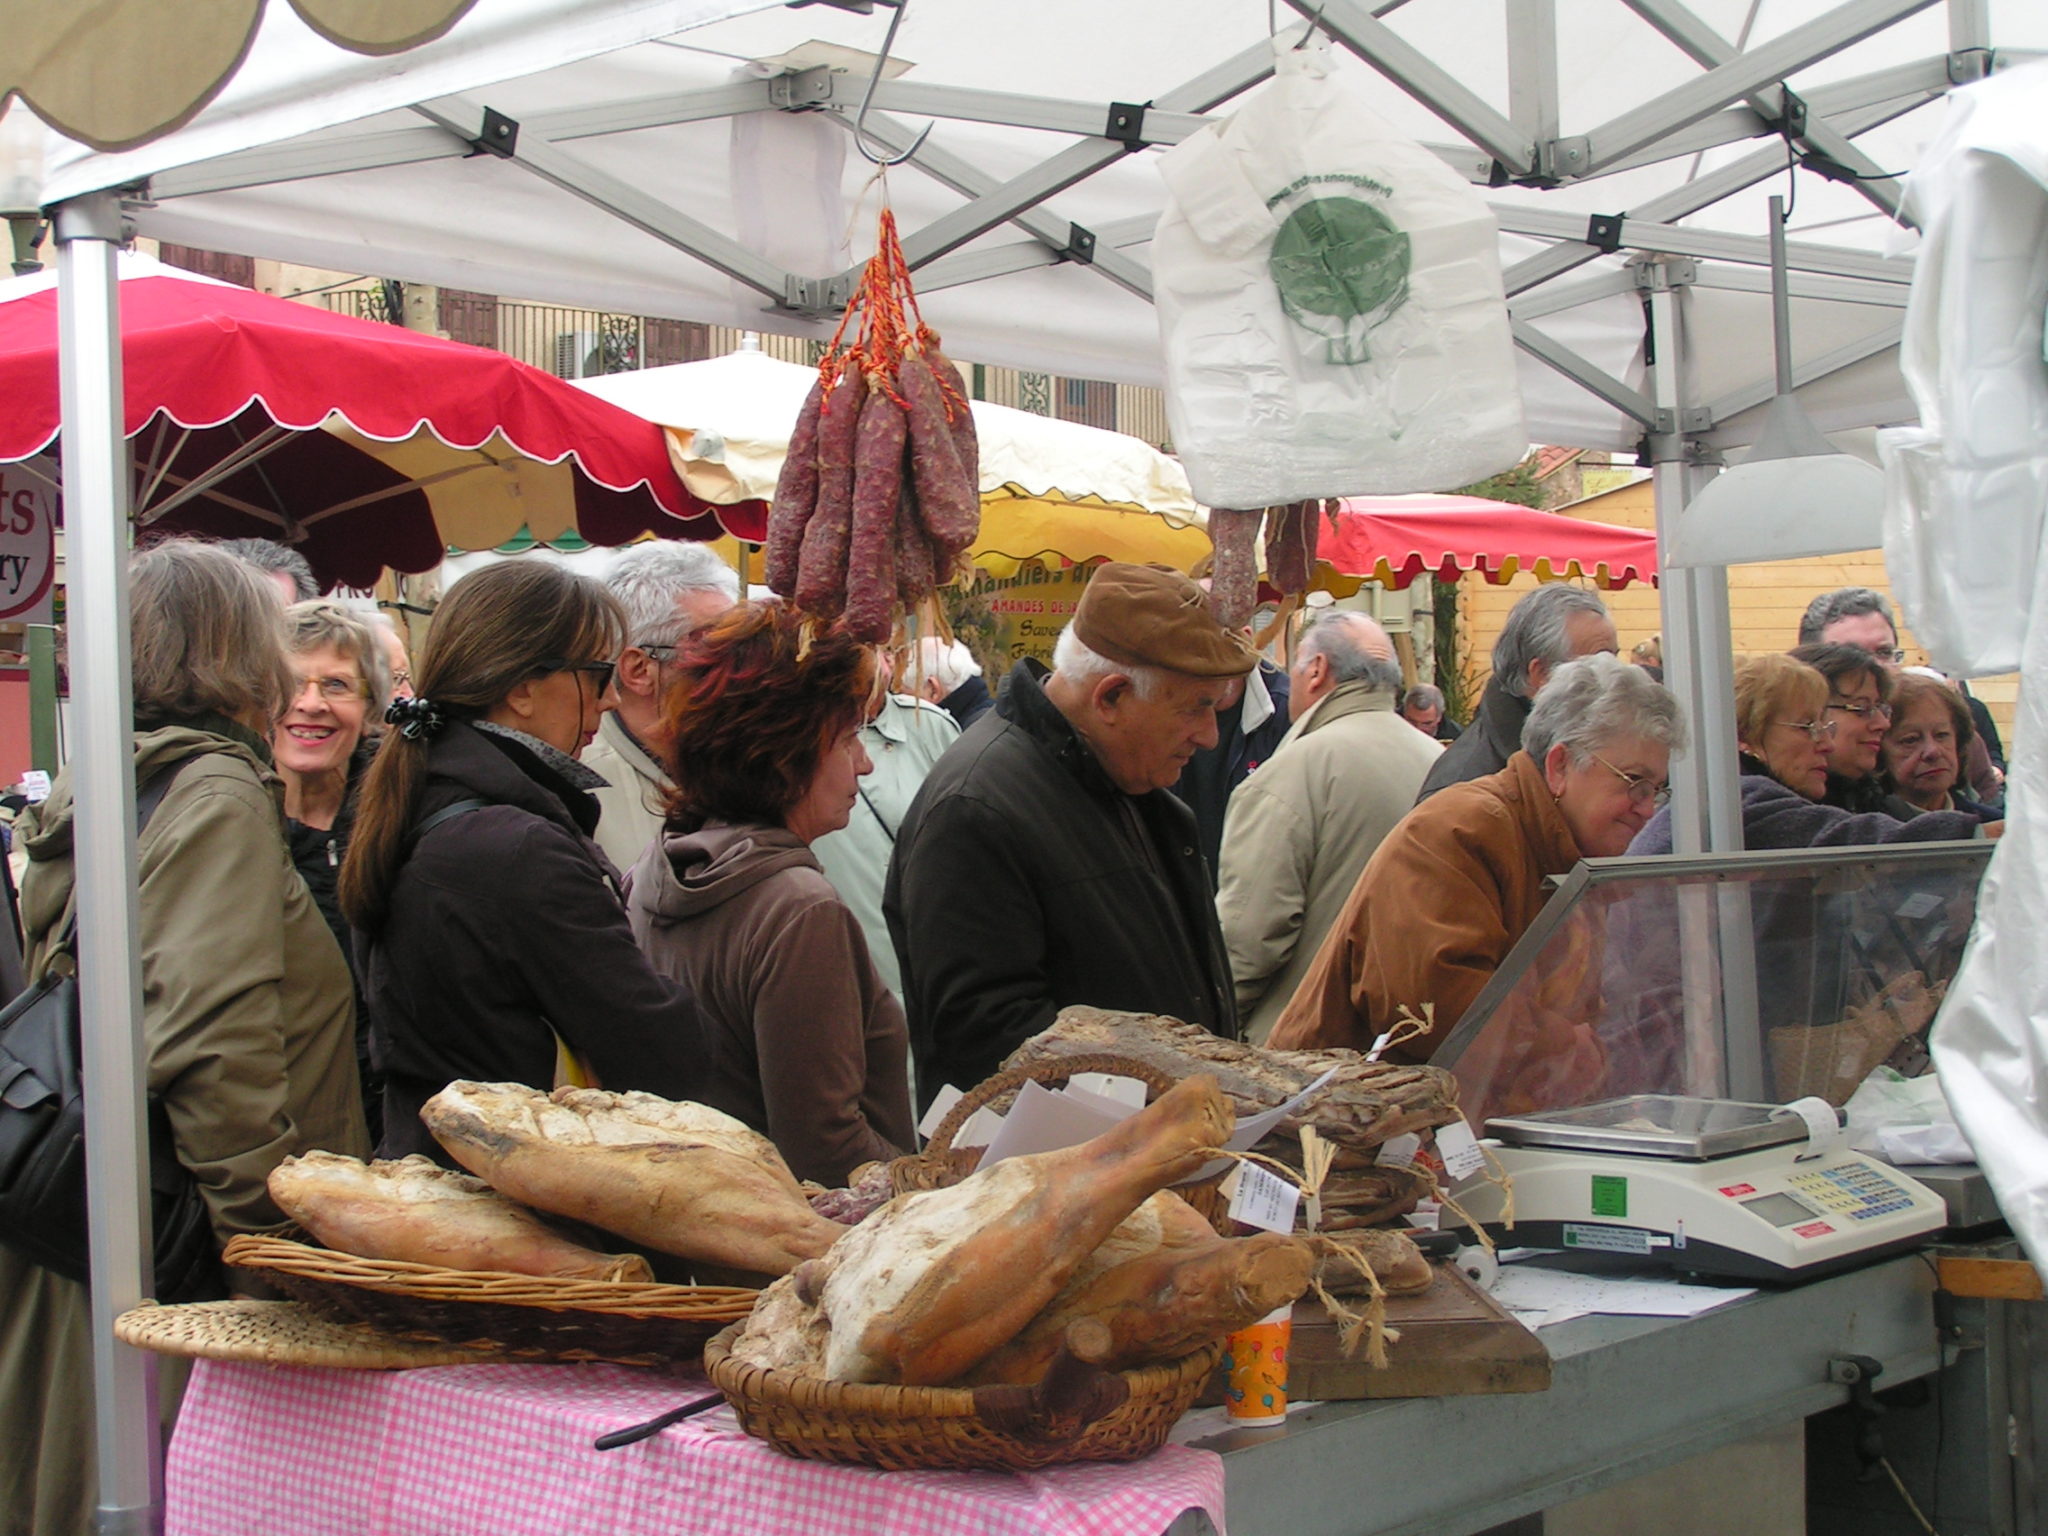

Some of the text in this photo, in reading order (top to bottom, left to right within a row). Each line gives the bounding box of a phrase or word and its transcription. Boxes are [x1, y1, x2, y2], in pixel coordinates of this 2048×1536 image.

[992, 600, 1044, 614] AMANDES
[1051, 601, 1063, 614] DE
[1011, 642, 1052, 660] Fabri
